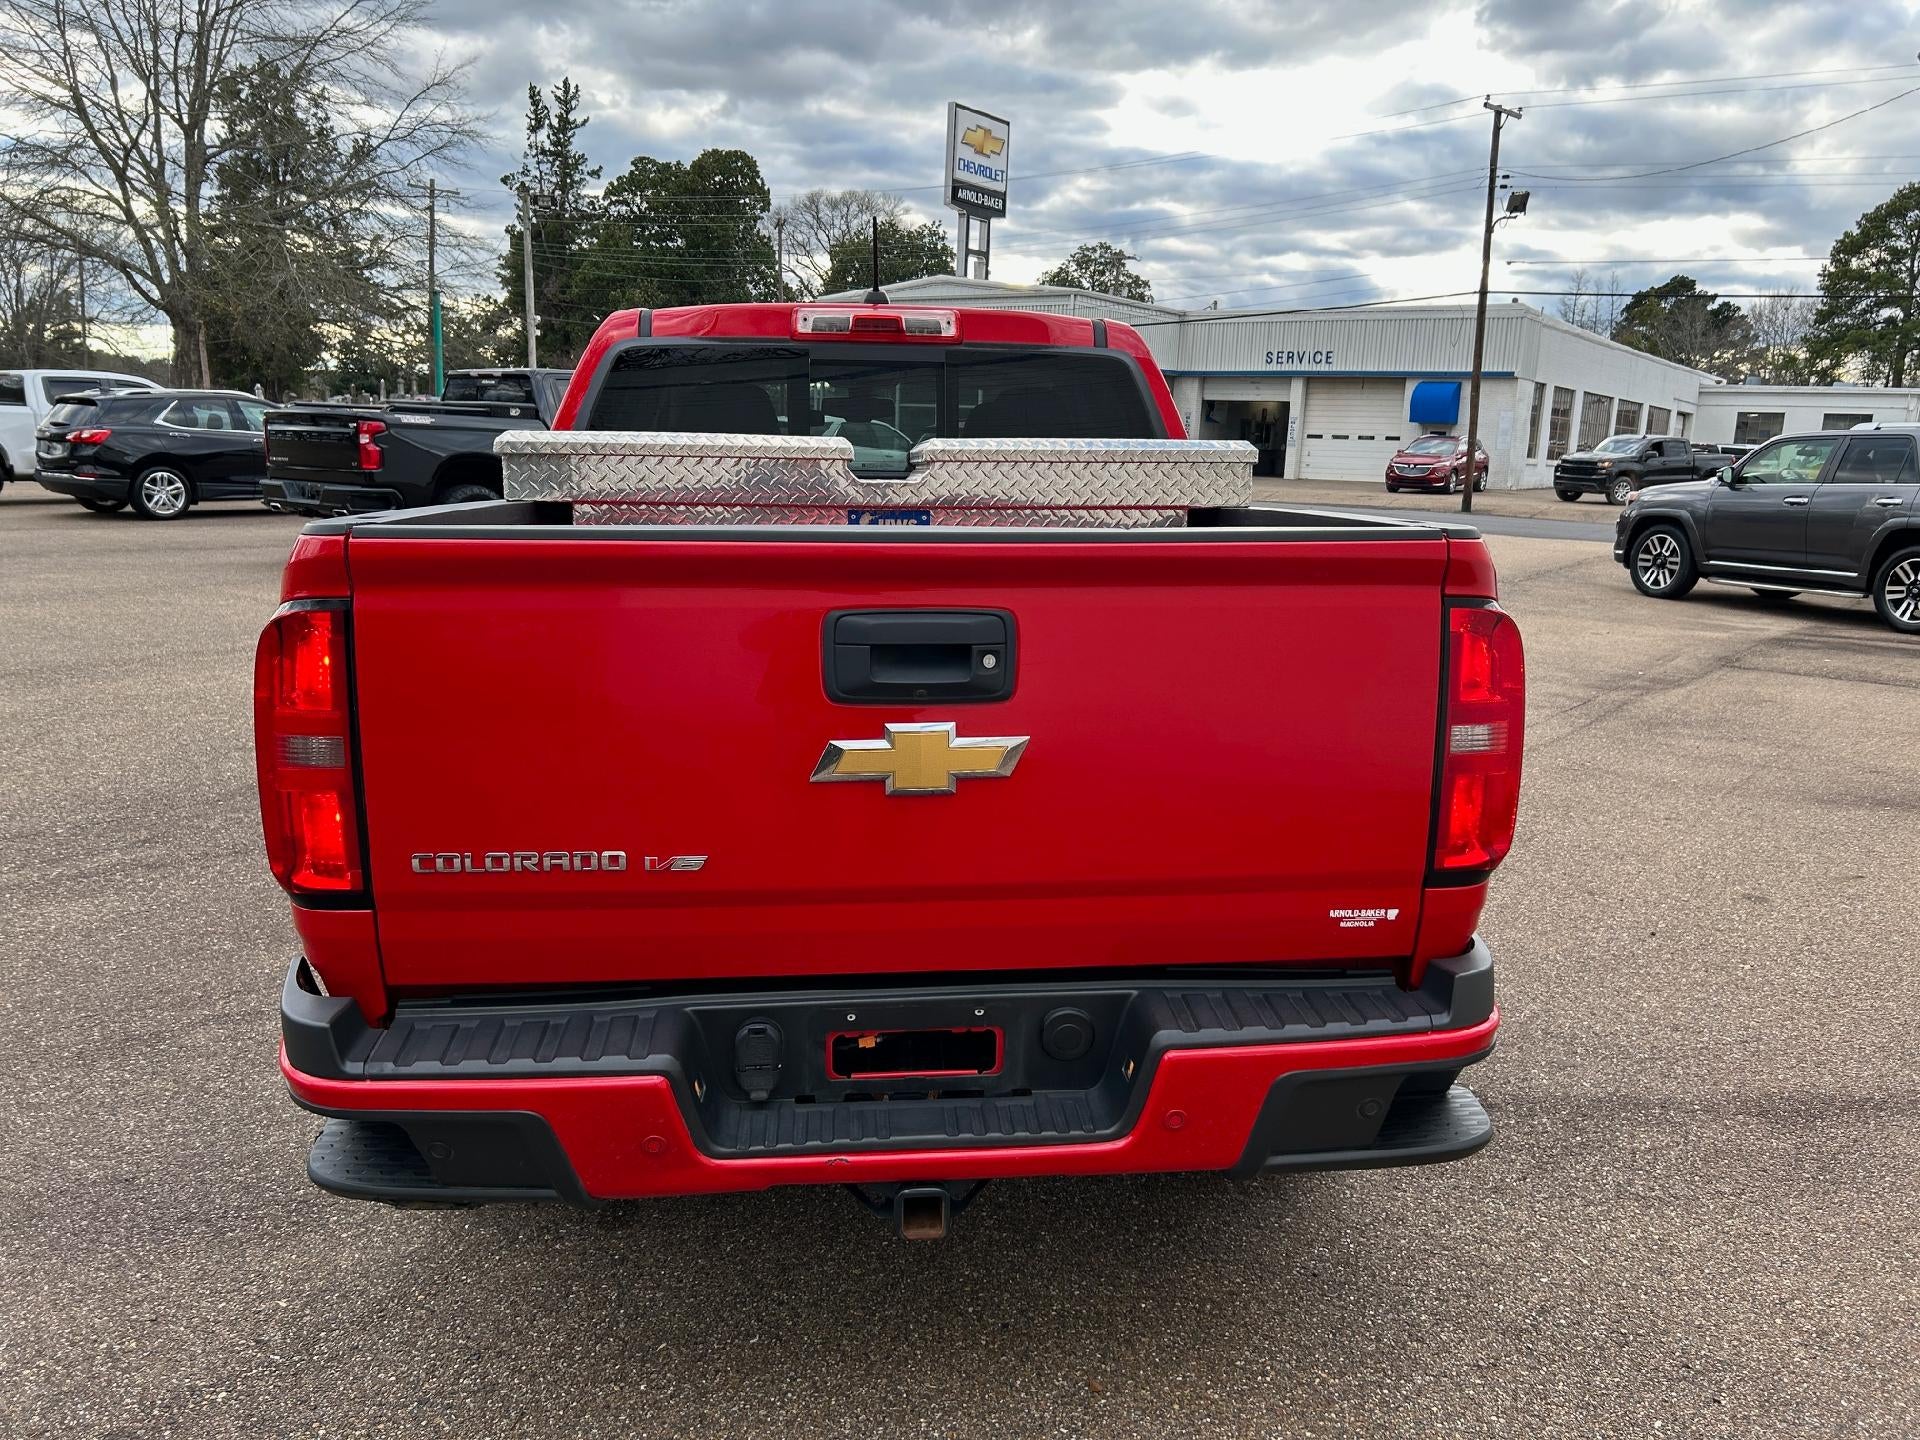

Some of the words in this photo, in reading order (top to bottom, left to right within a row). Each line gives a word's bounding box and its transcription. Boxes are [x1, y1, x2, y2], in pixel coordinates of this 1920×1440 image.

[957, 158, 1005, 183] CHEVROLET
[957, 188, 1003, 210] ARNOLD-BAKER
[1265, 350, 1333, 365] SERVICE
[411, 850, 627, 873] COLORADO
[1329, 908, 1386, 918] ARNOLD-BAKER
[1340, 920, 1375, 928] MAGNOLIA
